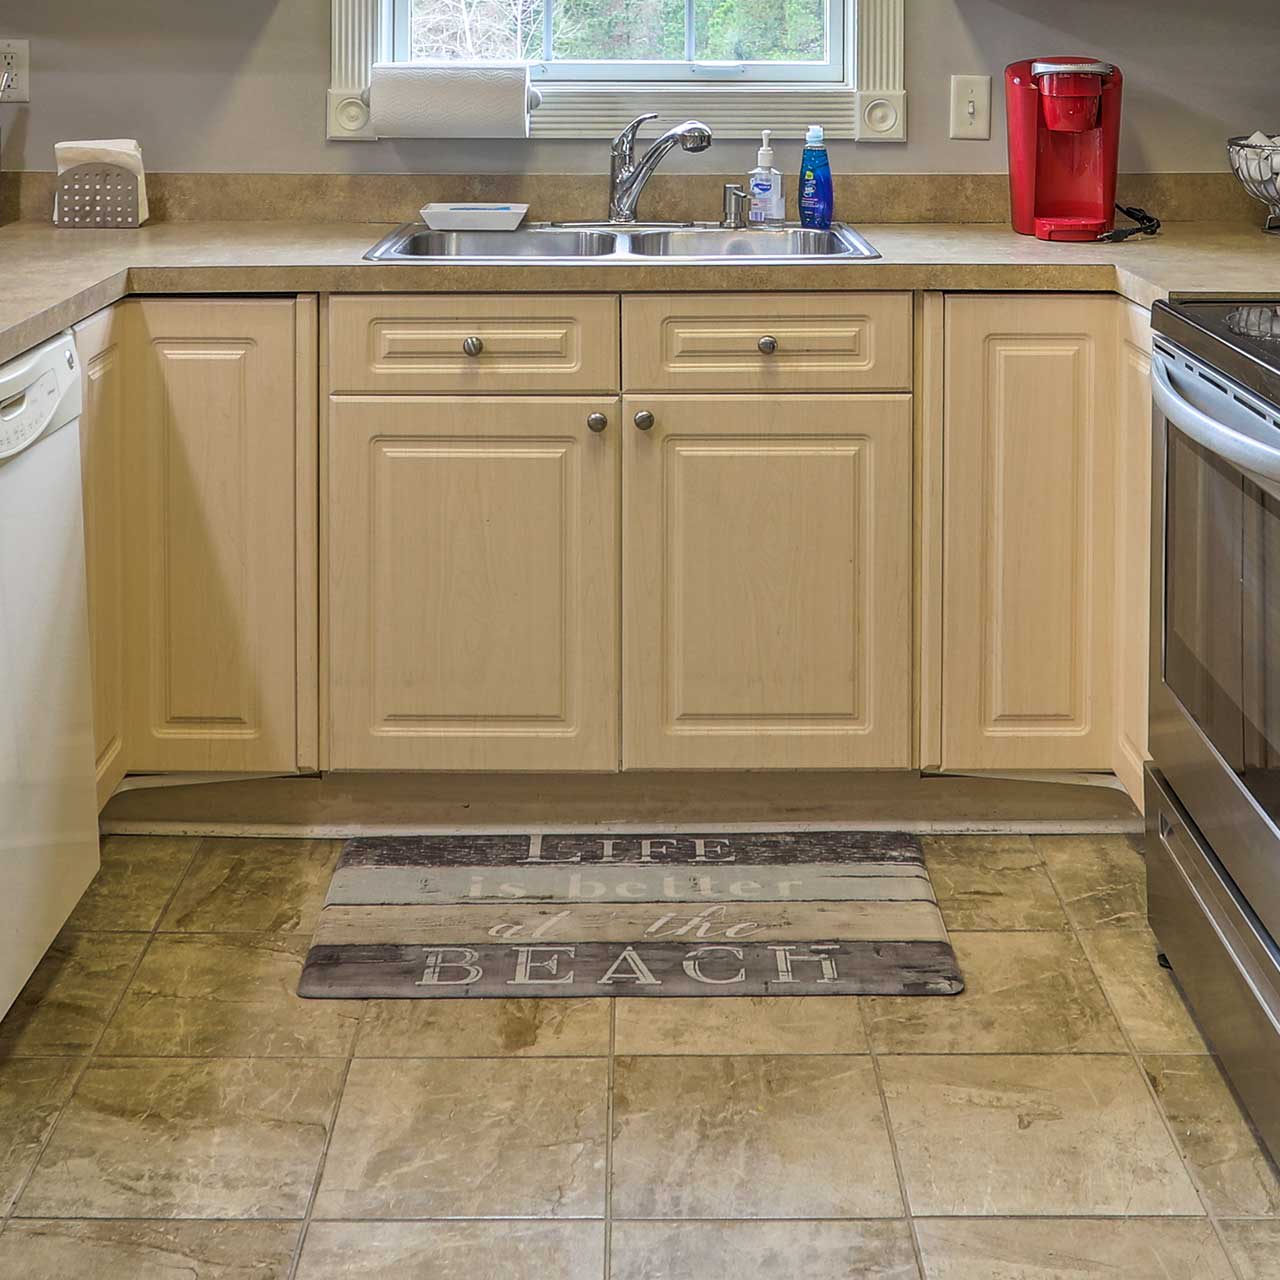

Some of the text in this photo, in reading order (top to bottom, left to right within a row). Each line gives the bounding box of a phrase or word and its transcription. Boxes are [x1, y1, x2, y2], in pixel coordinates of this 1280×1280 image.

[468, 872, 805, 900] is better
[486, 904, 768, 939] at the
[414, 944, 842, 987] BEACH
